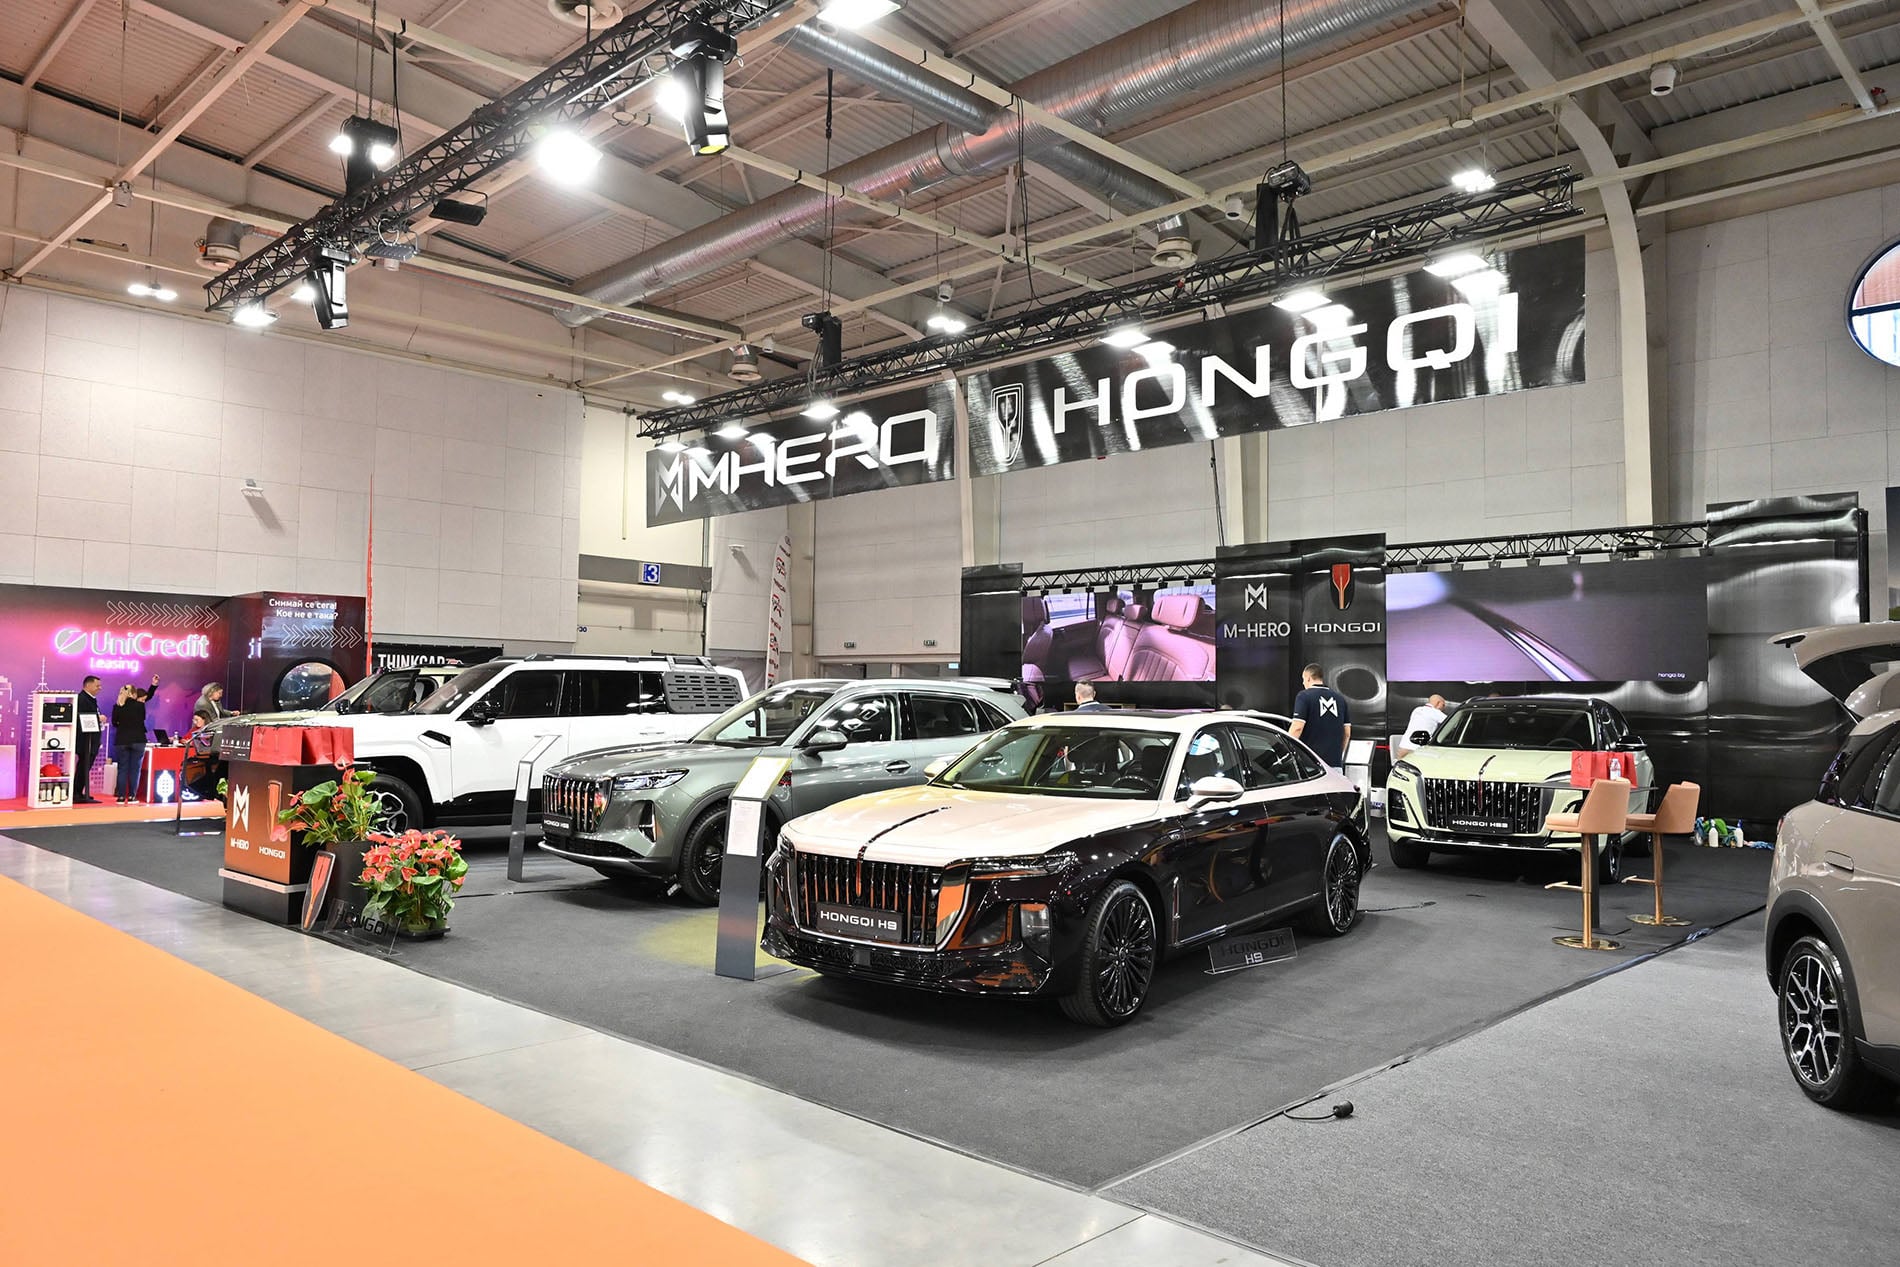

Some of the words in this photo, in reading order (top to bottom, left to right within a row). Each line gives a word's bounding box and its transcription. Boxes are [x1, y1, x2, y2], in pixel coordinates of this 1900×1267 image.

[1054, 292, 1518, 434] HONGQI
[647, 565, 658, 582] 3
[269, 598, 303, 608] Снимай
[316, 602, 337, 610] сега!
[276, 609, 293, 618] Кое
[294, 611, 305, 619] не
[314, 612, 339, 620] така?
[1223, 622, 1291, 638] M-HERO
[1305, 622, 1381, 633] HONGQI
[91, 631, 210, 659] UniCredit
[90, 657, 140, 672] Leasing
[1452, 819, 1488, 827] HONGQI
[258, 846, 286, 860] HONGQI
[820, 910, 874, 927] HONGQI
[878, 919, 897, 931] H9
[1221, 935, 1286, 956] HONGQI
[1244, 952, 1264, 965] H9
